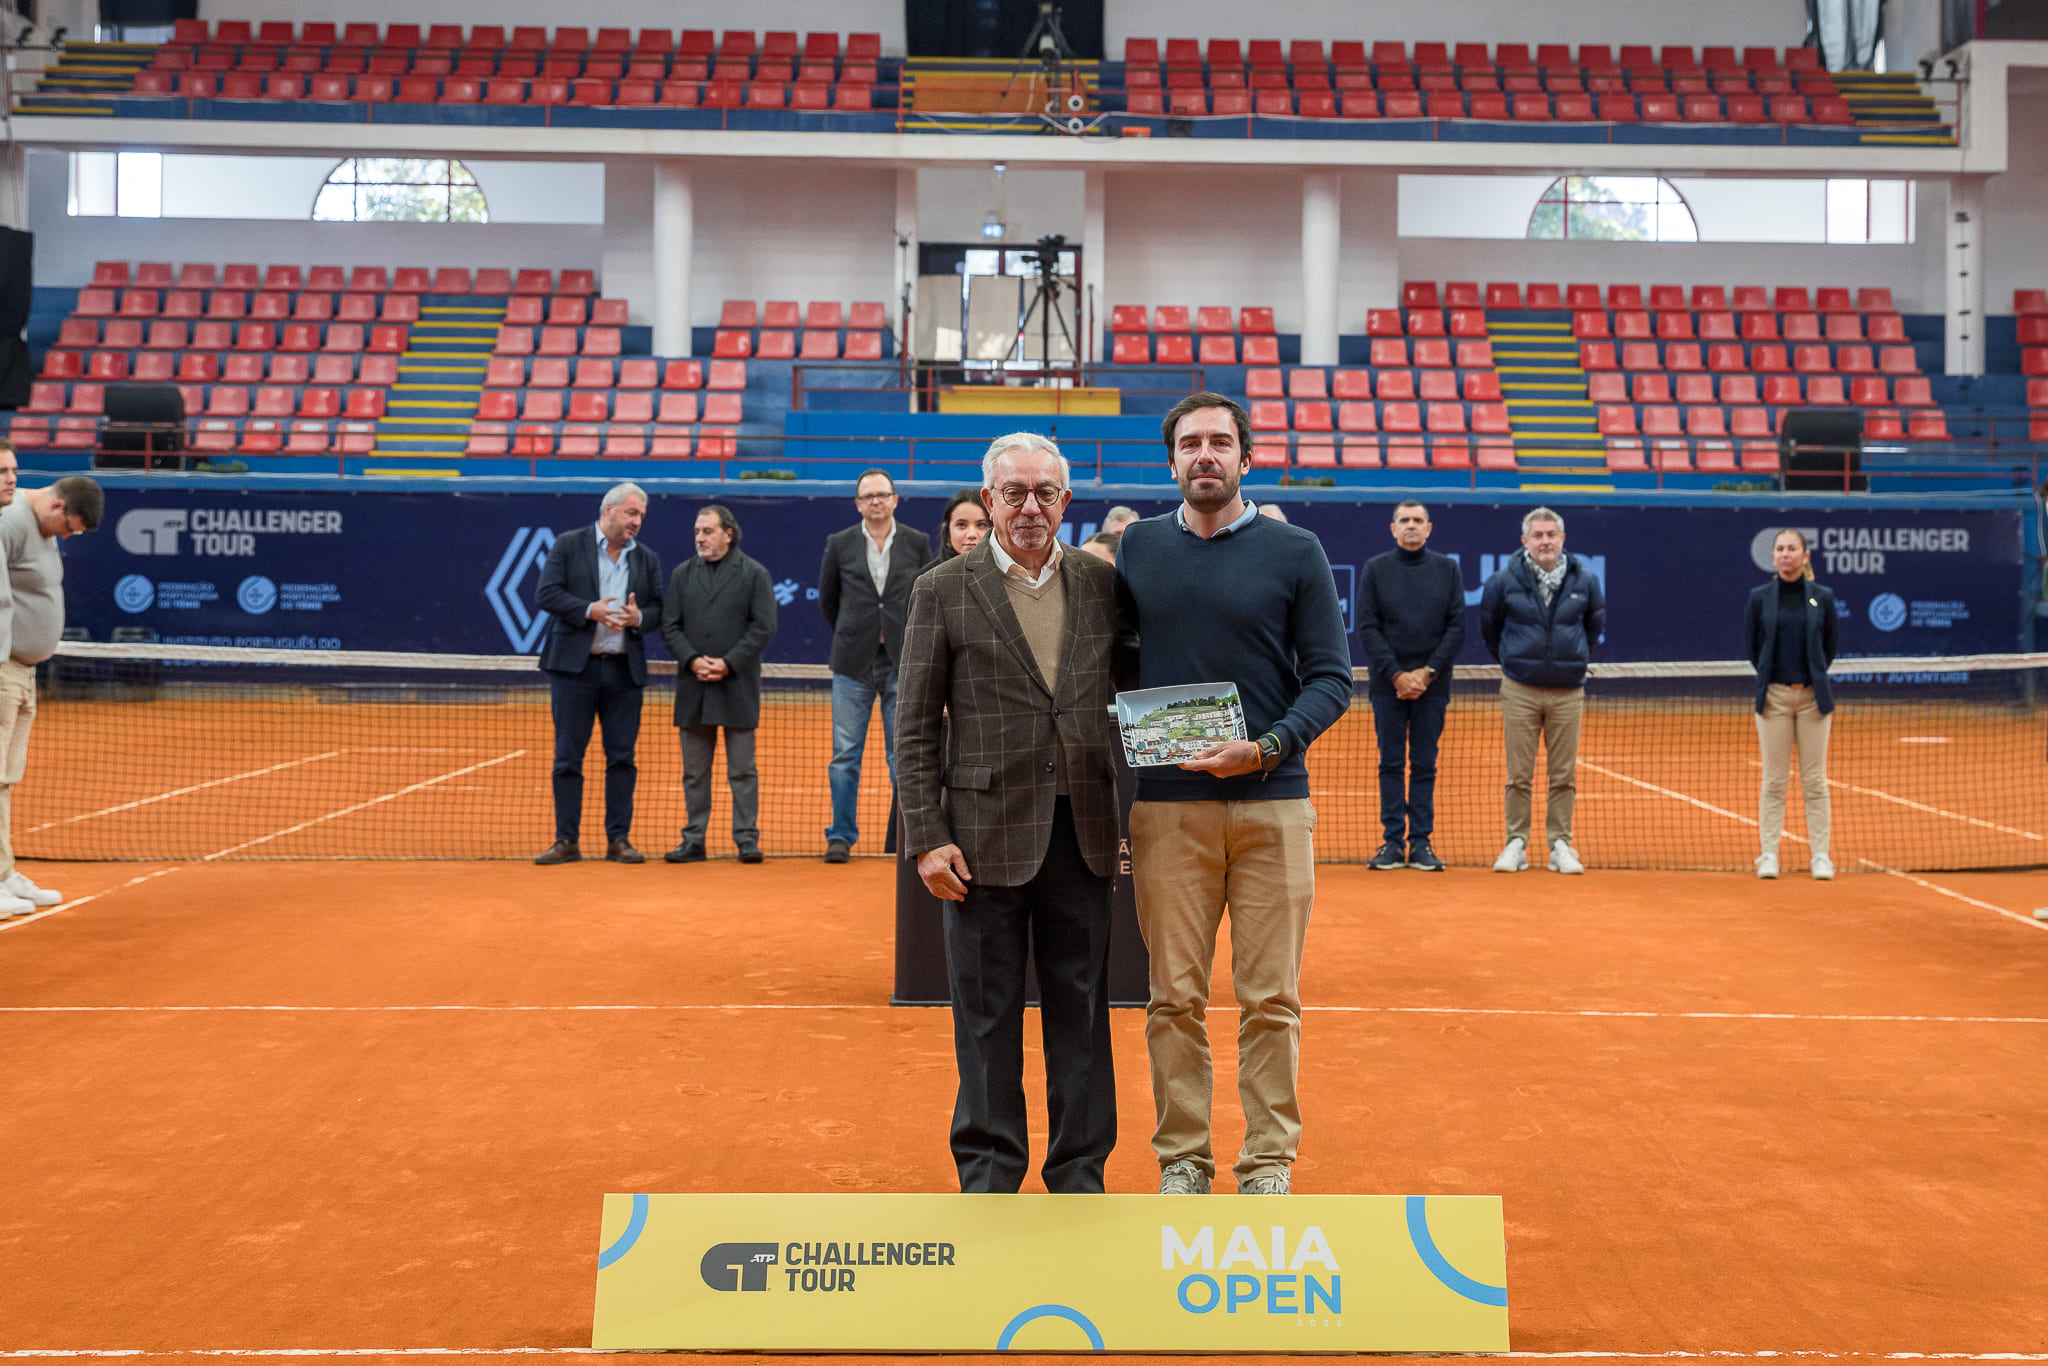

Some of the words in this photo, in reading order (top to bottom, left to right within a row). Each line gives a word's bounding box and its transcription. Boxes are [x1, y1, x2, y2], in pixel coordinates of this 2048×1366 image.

[190, 509, 343, 534] CHALLENGER
[191, 533, 256, 556] TOUR
[1822, 528, 1970, 552] CHALLENGER
[1823, 551, 1886, 574] TOUR
[318, 637, 342, 650] DO
[750, 1253, 776, 1263] ATP
[785, 1242, 956, 1266] CHALLENGER
[1161, 1225, 1341, 1271] MAIA
[785, 1268, 856, 1292] TOUR
[1177, 1273, 1342, 1314] OPEN
[1296, 1318, 1343, 1327] 2025
